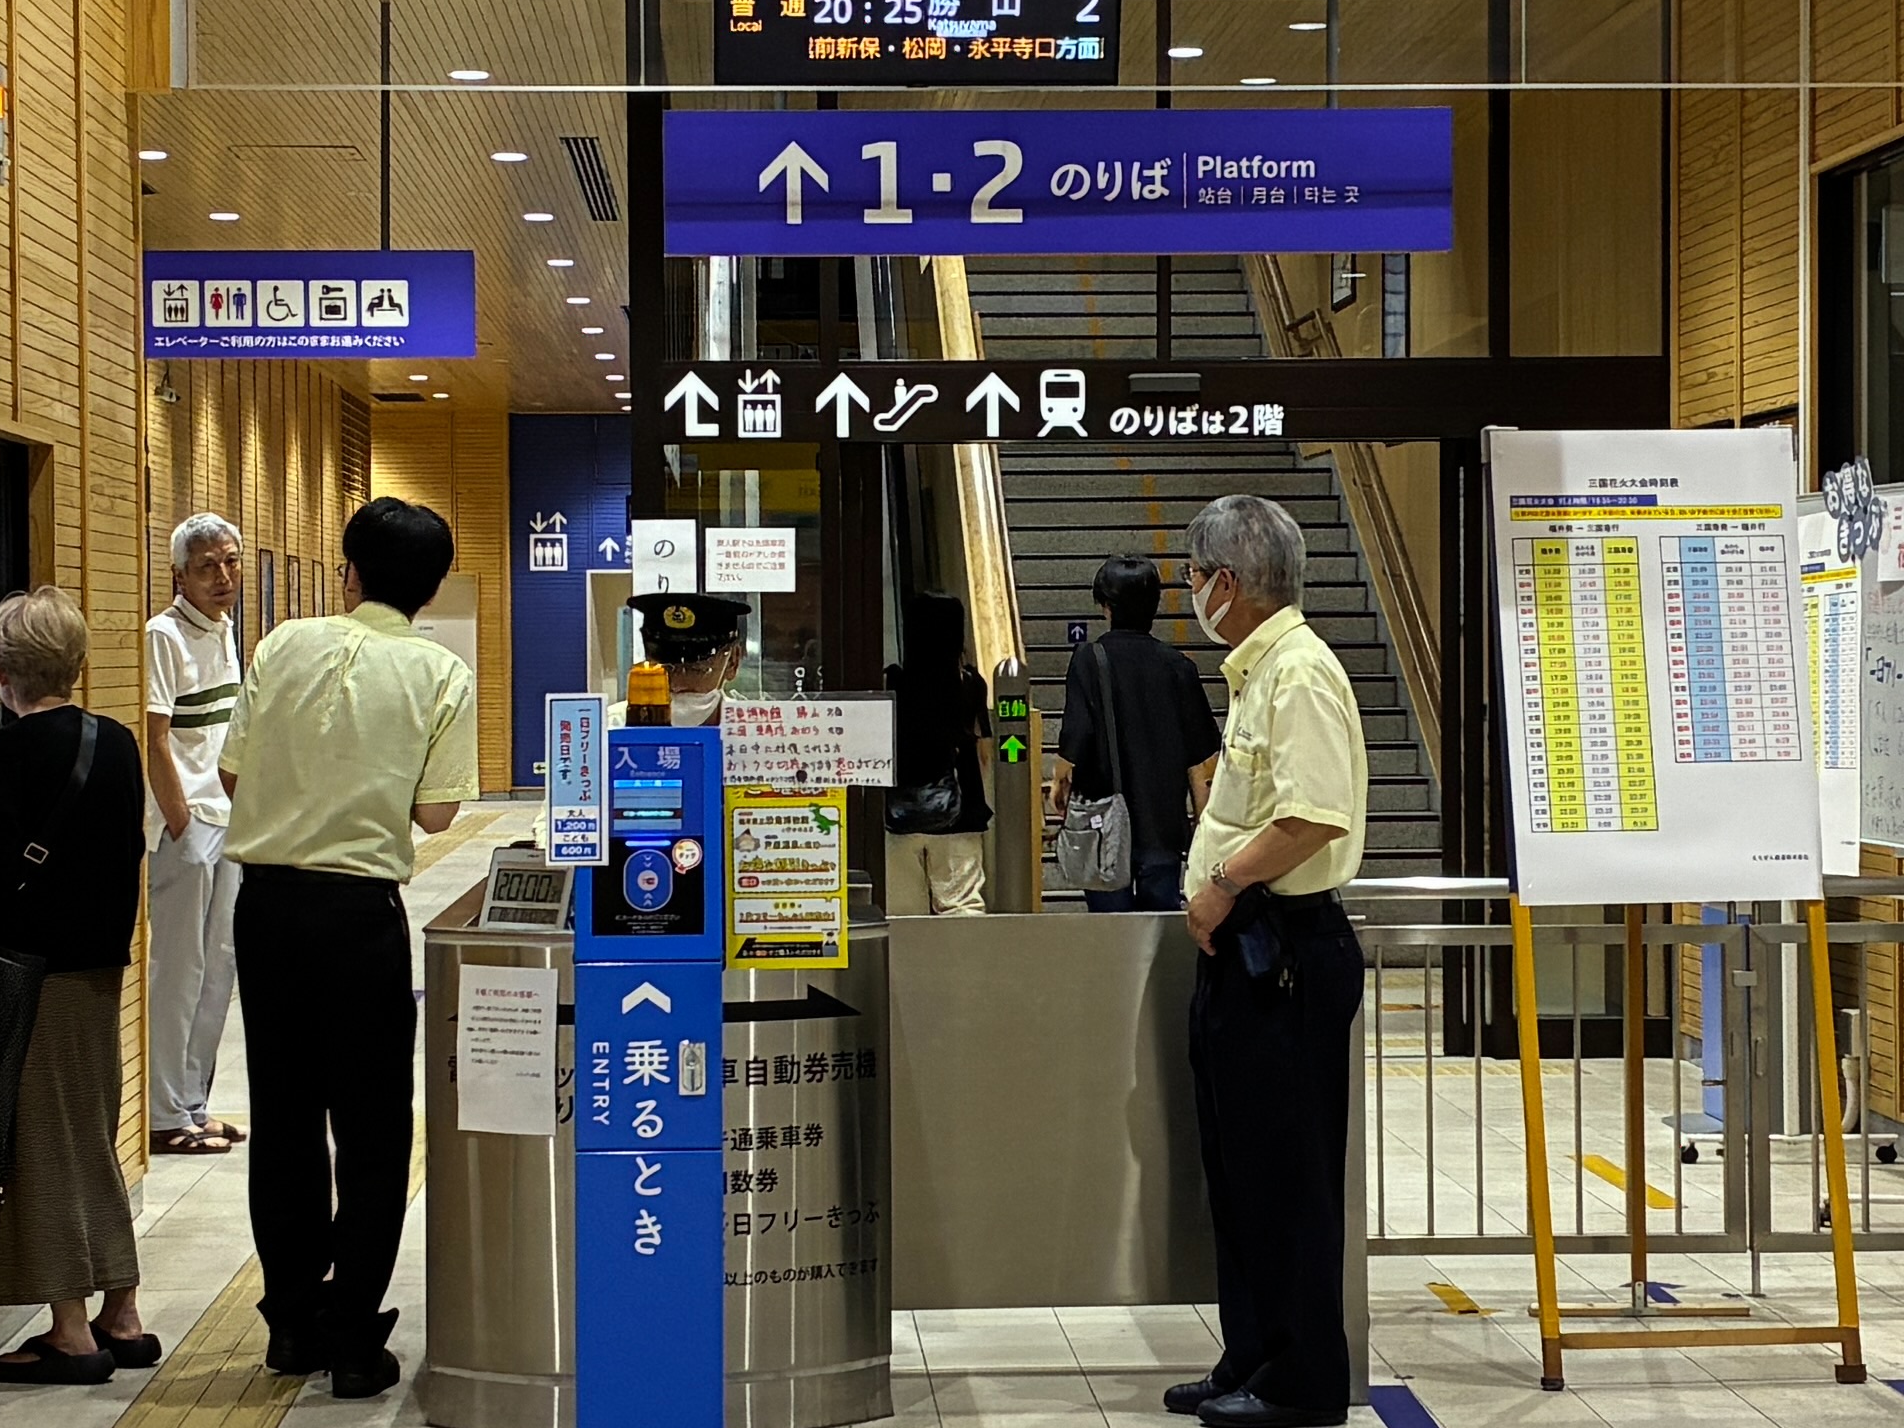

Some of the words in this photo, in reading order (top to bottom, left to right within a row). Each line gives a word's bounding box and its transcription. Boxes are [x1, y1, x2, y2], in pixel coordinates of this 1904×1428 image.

[729, 18, 763, 33] Local
[808, 37, 1106, 59] 前新保・松岡・永平寺口方面
[1048, 155, 1171, 203] のりば
[1197, 155, 1316, 179] Platform
[1198, 186, 1233, 205] 站台
[1251, 186, 1286, 204] 月台
[1343, 185, 1360, 204] 곳
[1108, 403, 1286, 438] のりばは2階
[614, 745, 682, 770] 入場
[592, 1042, 610, 1126] ENTRY
[621, 1039, 671, 1256] 乗るとき
[722, 1123, 825, 1152] 通乗車券
[723, 1168, 779, 1195] 数券
[724, 1201, 881, 1237] 日フリーきっぷ
